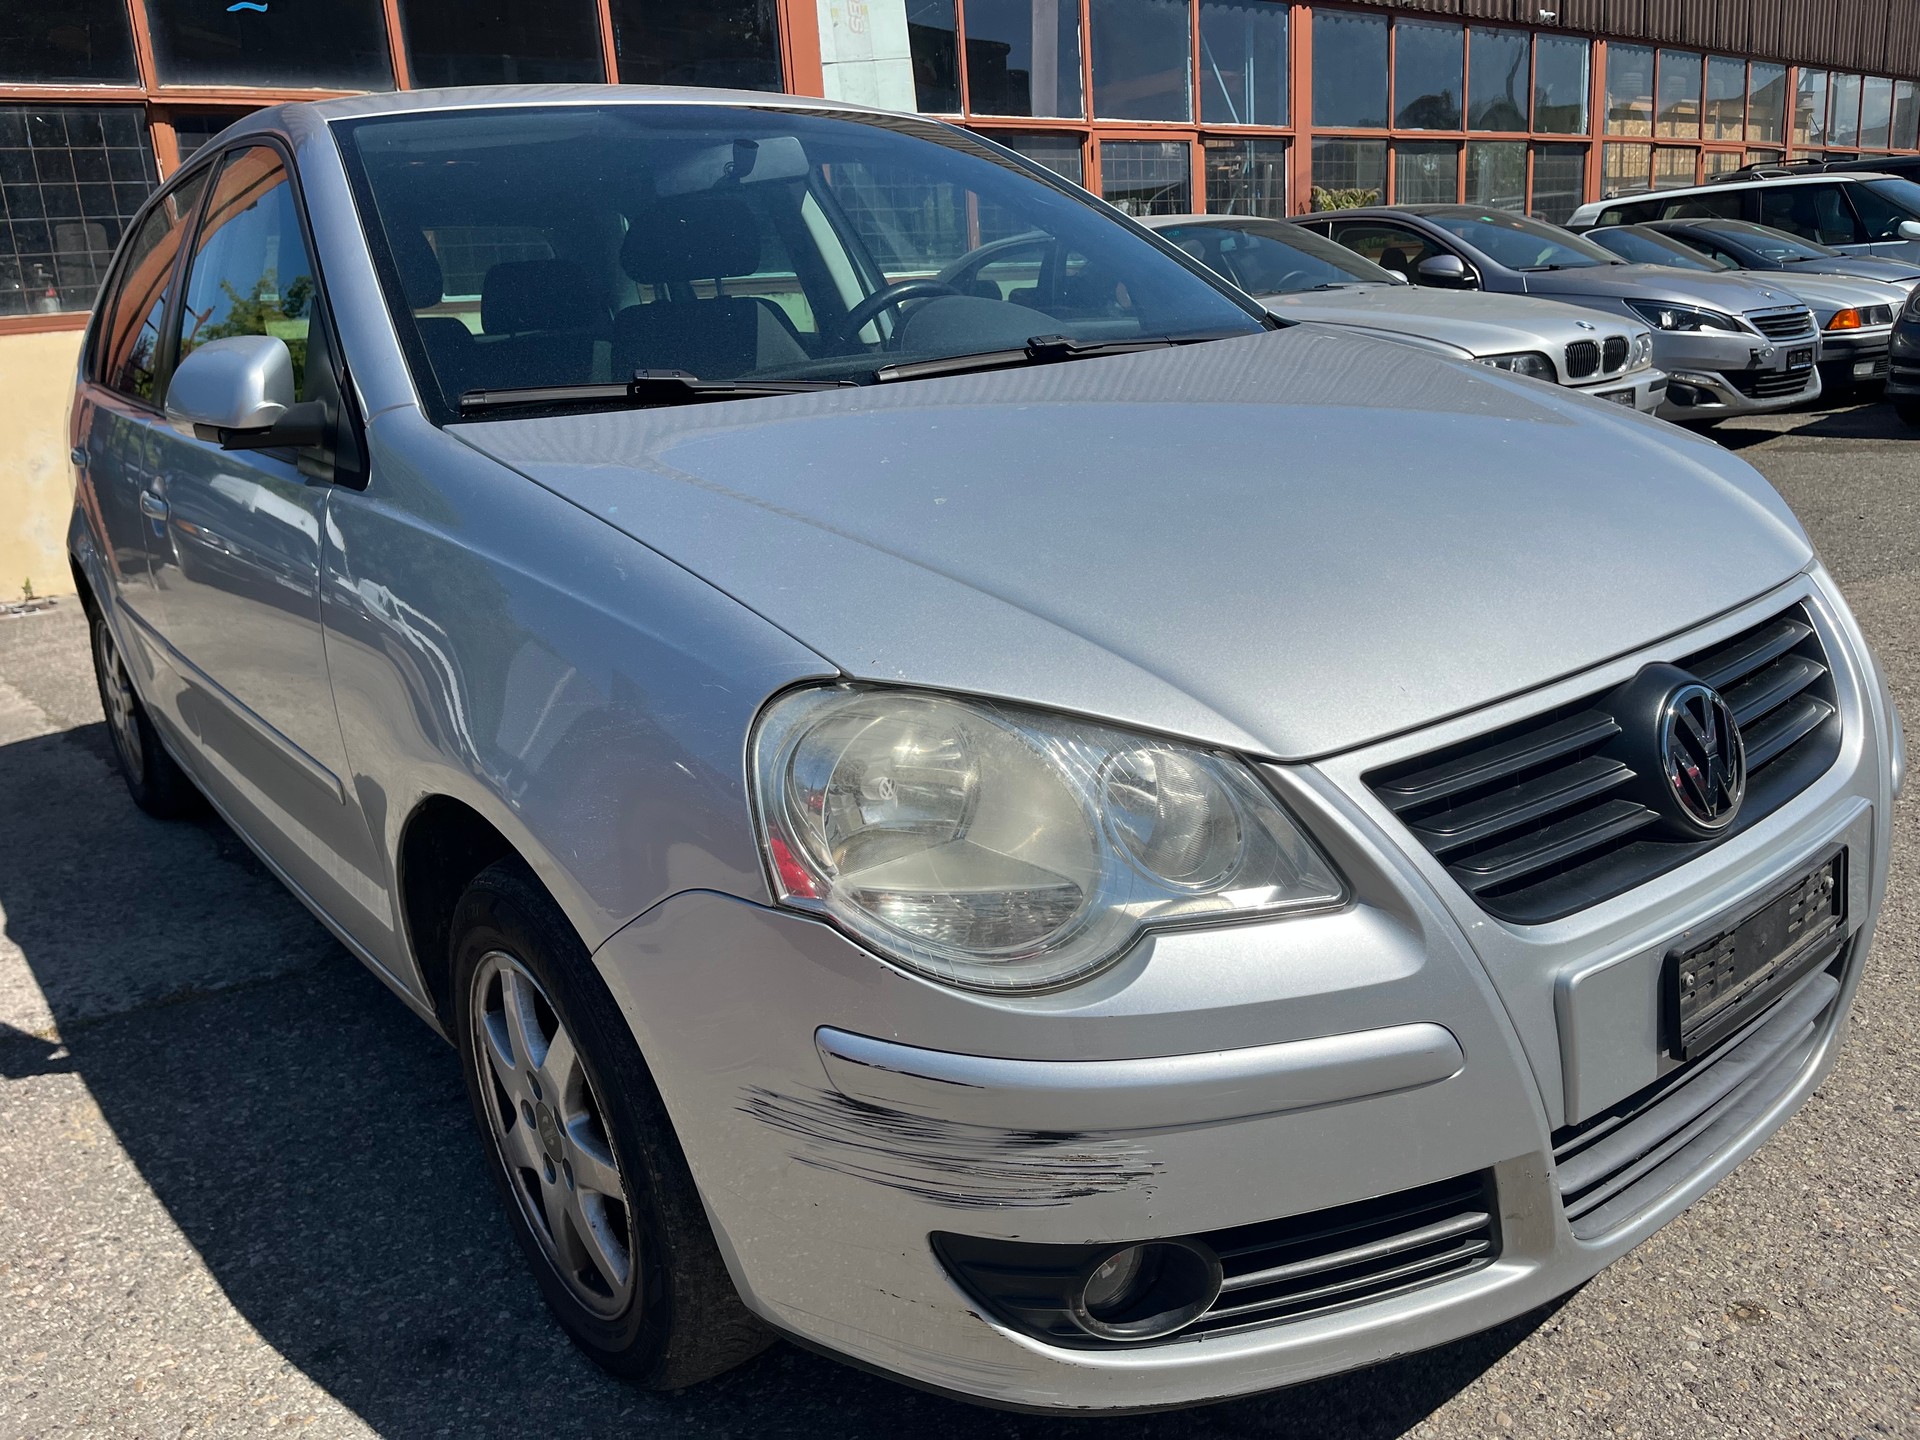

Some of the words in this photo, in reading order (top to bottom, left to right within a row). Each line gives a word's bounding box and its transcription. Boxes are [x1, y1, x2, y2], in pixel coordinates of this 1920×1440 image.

[847, 0, 864, 34] SE
[1661, 685, 1746, 829] VW
[879, 777, 898, 800] VW
